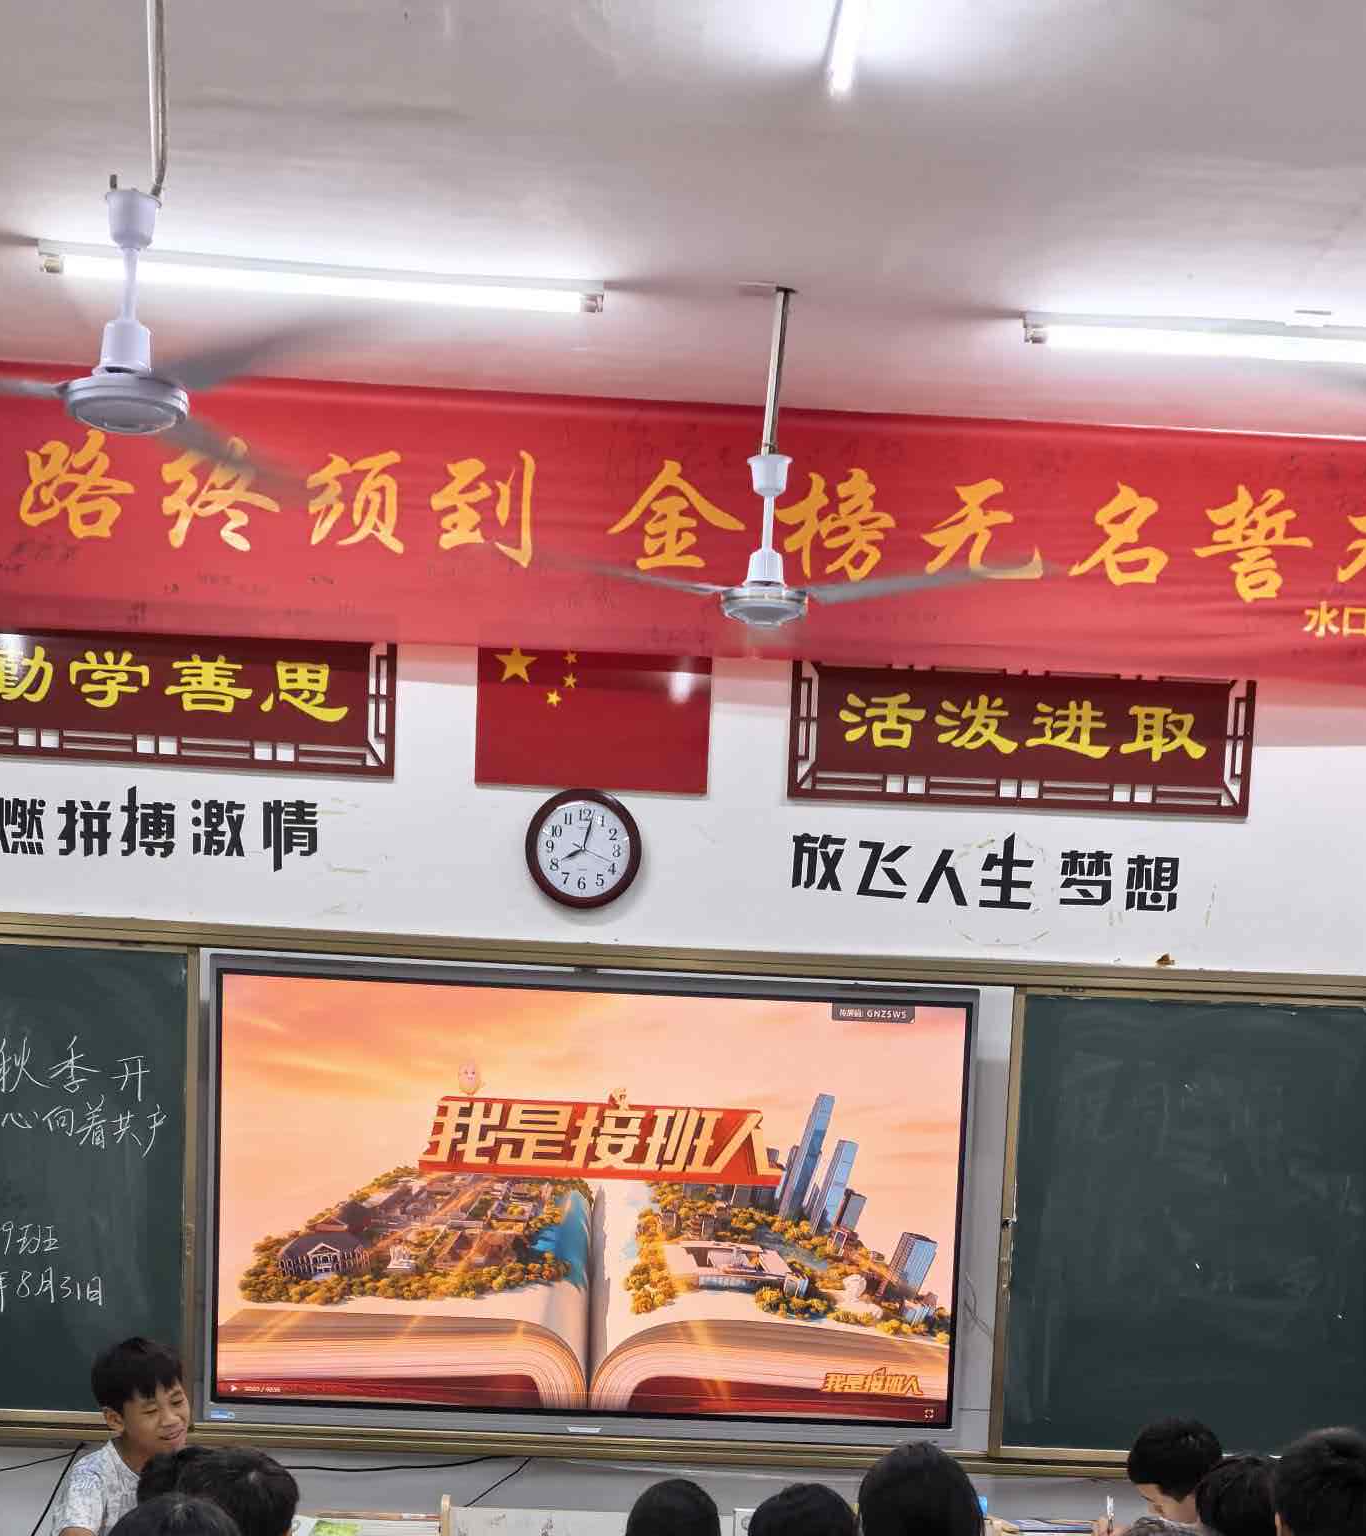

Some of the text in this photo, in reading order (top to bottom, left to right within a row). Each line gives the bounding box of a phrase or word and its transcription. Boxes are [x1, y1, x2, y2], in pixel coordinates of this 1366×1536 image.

[838, 692, 1208, 762] 活泼进取
[563, 812, 573, 825] 11
[578, 809, 592, 822] 12
[550, 824, 562, 838] 10
[608, 828, 618, 841] 2
[546, 840, 555, 853] 9
[612, 844, 621, 858] 3
[549, 858, 559, 871] 8
[607, 862, 617, 875] 4
[561, 872, 571, 885] 7
[791, 832, 1180, 913] 放飞人生梦想
[577, 876, 586, 890] 6
[595, 873, 605, 887] 5
[426, 1099, 780, 1177] 我是接班人
